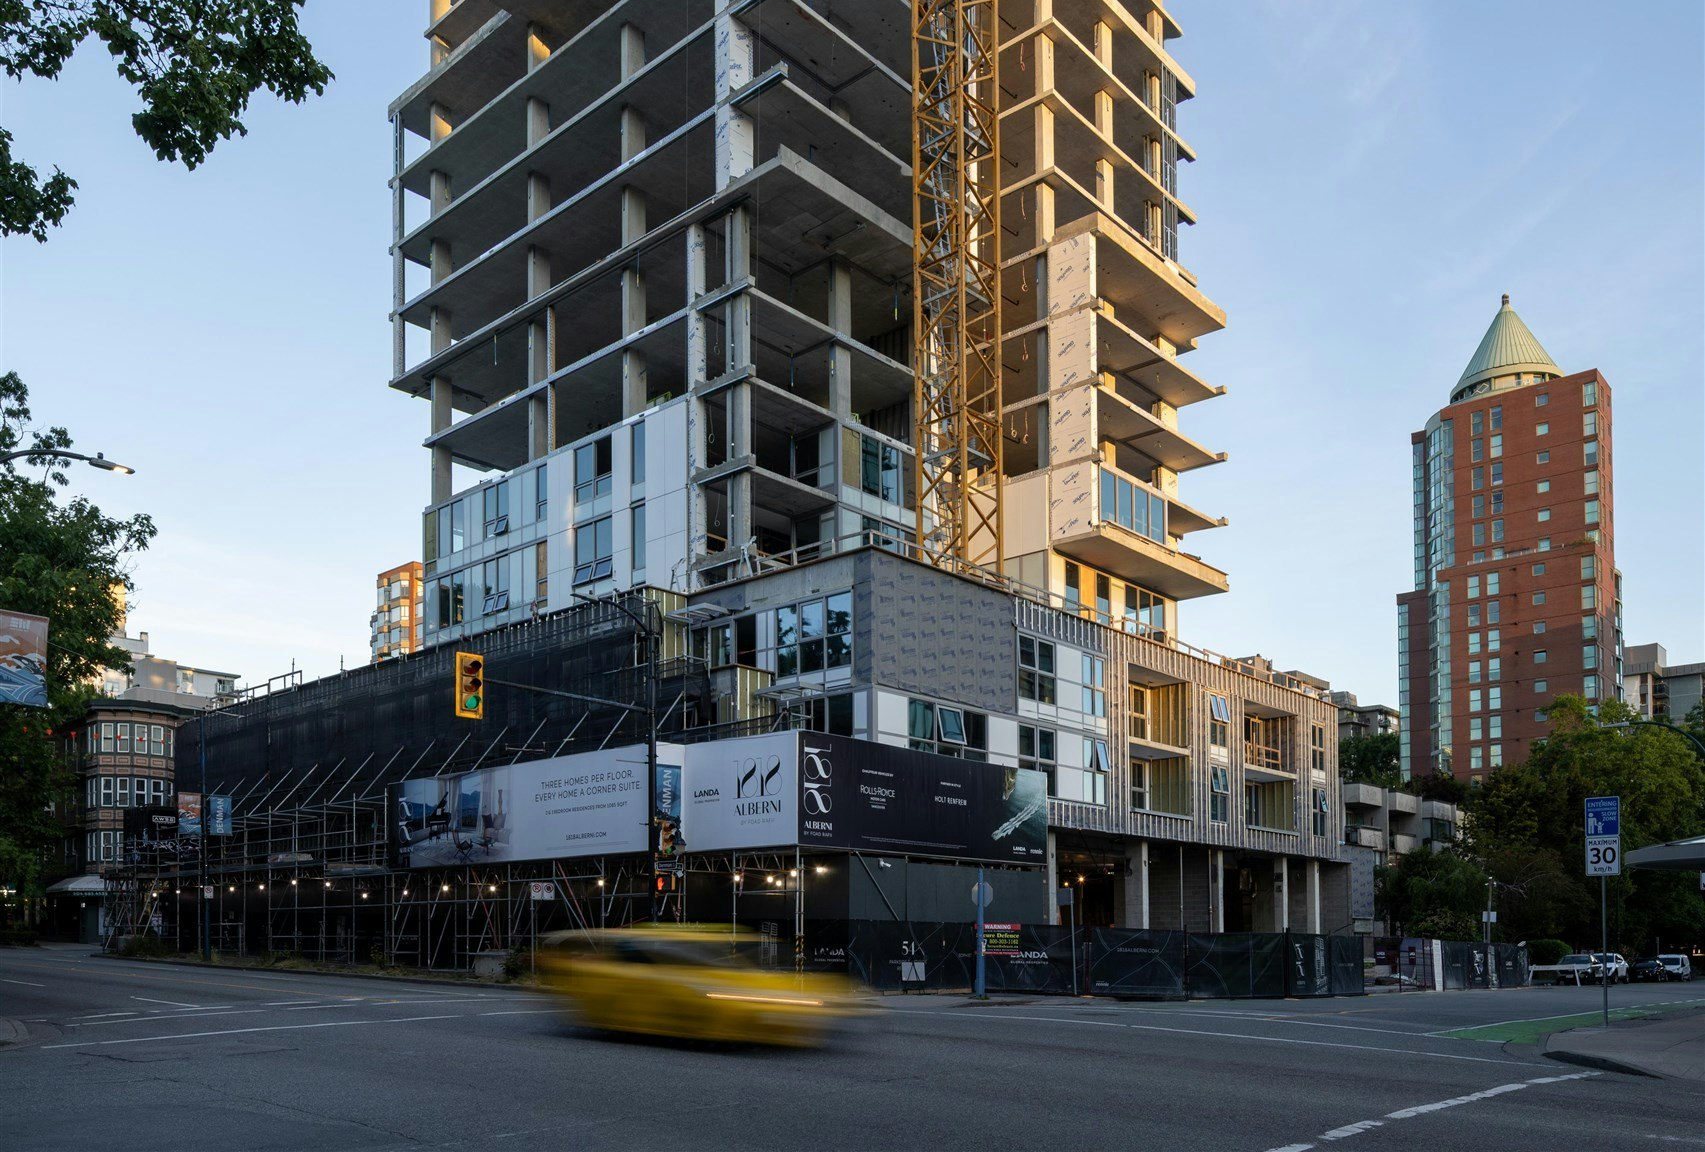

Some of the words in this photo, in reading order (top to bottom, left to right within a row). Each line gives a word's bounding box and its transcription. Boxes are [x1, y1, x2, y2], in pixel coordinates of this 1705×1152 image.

[541, 779, 562, 789] THREE
[564, 775, 589, 786] HOMES
[591, 773, 605, 782] PER
[607, 769, 634, 780] FLOOR.
[731, 754, 783, 799] 1818
[534, 792, 556, 802] EVERY
[558, 789, 577, 799] HOME
[580, 788, 585, 796] A
[586, 783, 616, 796] CORNER
[662, 769, 672, 814] ENMAN
[694, 788, 719, 798] LANDA
[860, 784, 896, 798] ROLLS-ROYCE
[733, 800, 781, 816] ALBERNI
[934, 795, 946, 803] HOLT
[947, 796, 967, 806] RENFREW
[1587, 800, 1617, 808] ENTERING
[216, 798, 224, 833] DENMAN
[804, 820, 832, 830] ALBERNI
[1589, 847, 1616, 864] 30
